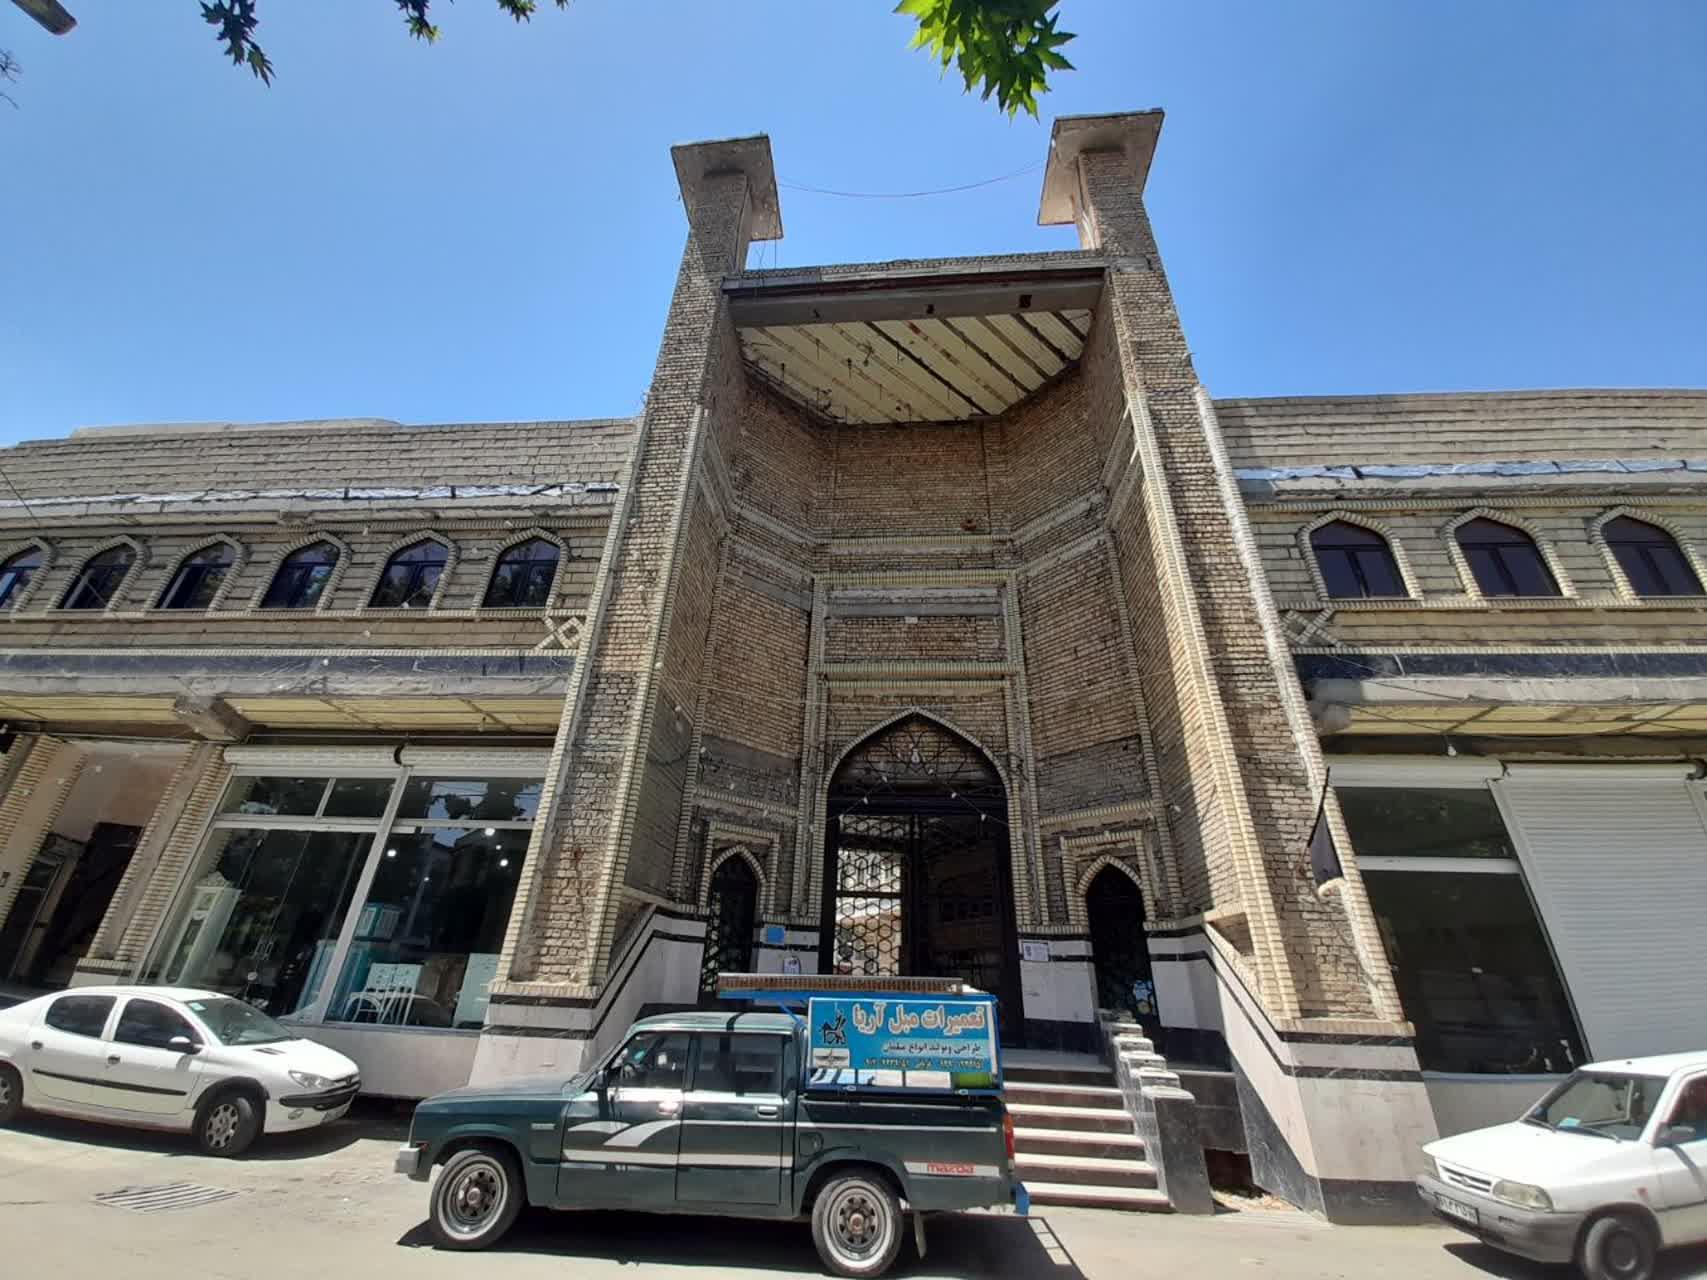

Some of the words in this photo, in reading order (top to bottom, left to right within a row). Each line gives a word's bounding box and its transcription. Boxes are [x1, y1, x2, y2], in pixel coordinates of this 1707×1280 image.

[888, 1004, 920, 1034] مبل
[921, 1004, 985, 1035] تعمیرات
[927, 1163, 976, 1175] mazda
